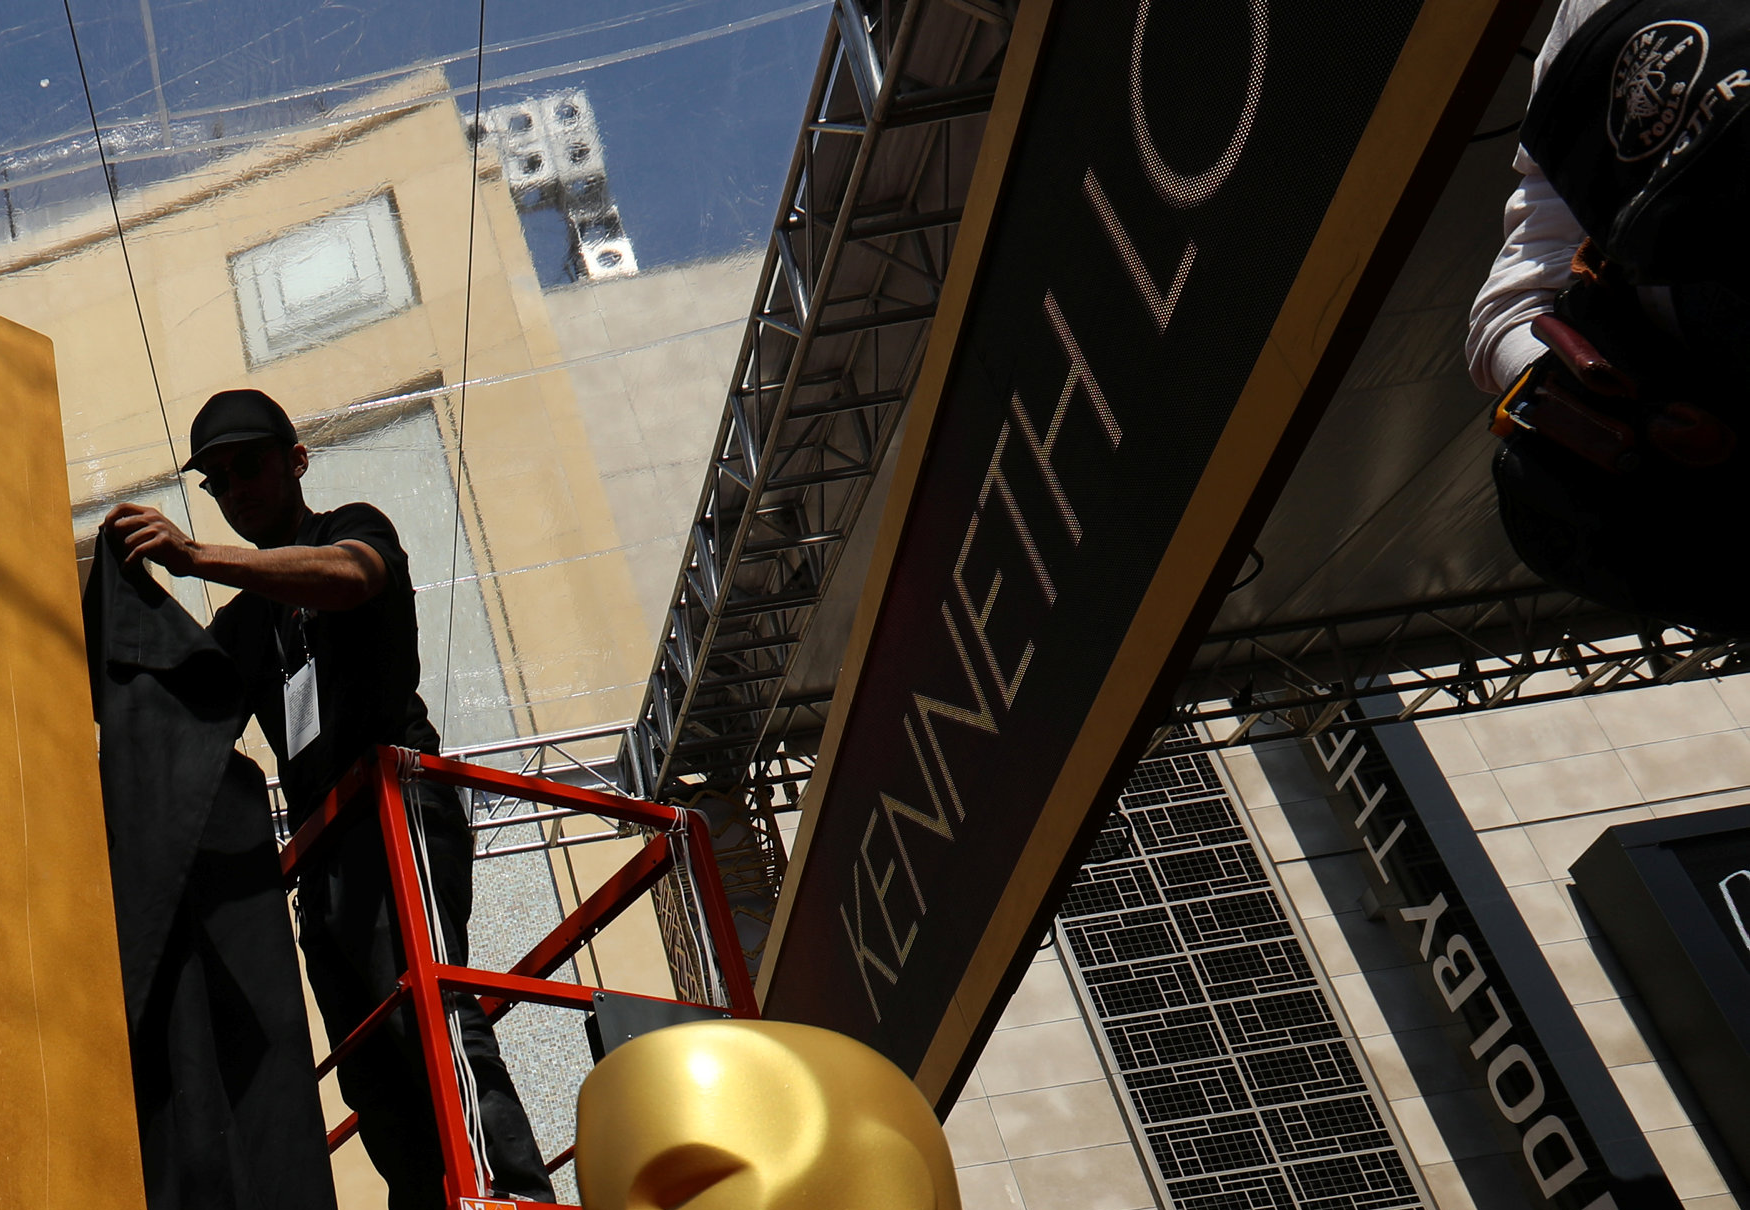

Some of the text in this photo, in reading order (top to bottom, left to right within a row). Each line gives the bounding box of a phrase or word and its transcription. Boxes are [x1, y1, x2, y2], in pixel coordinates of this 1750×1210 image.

[1637, 81, 1687, 147] TOOLS
[838, 288, 1123, 1022] KENNETH
[1399, 892, 1590, 1199] DOLBY
